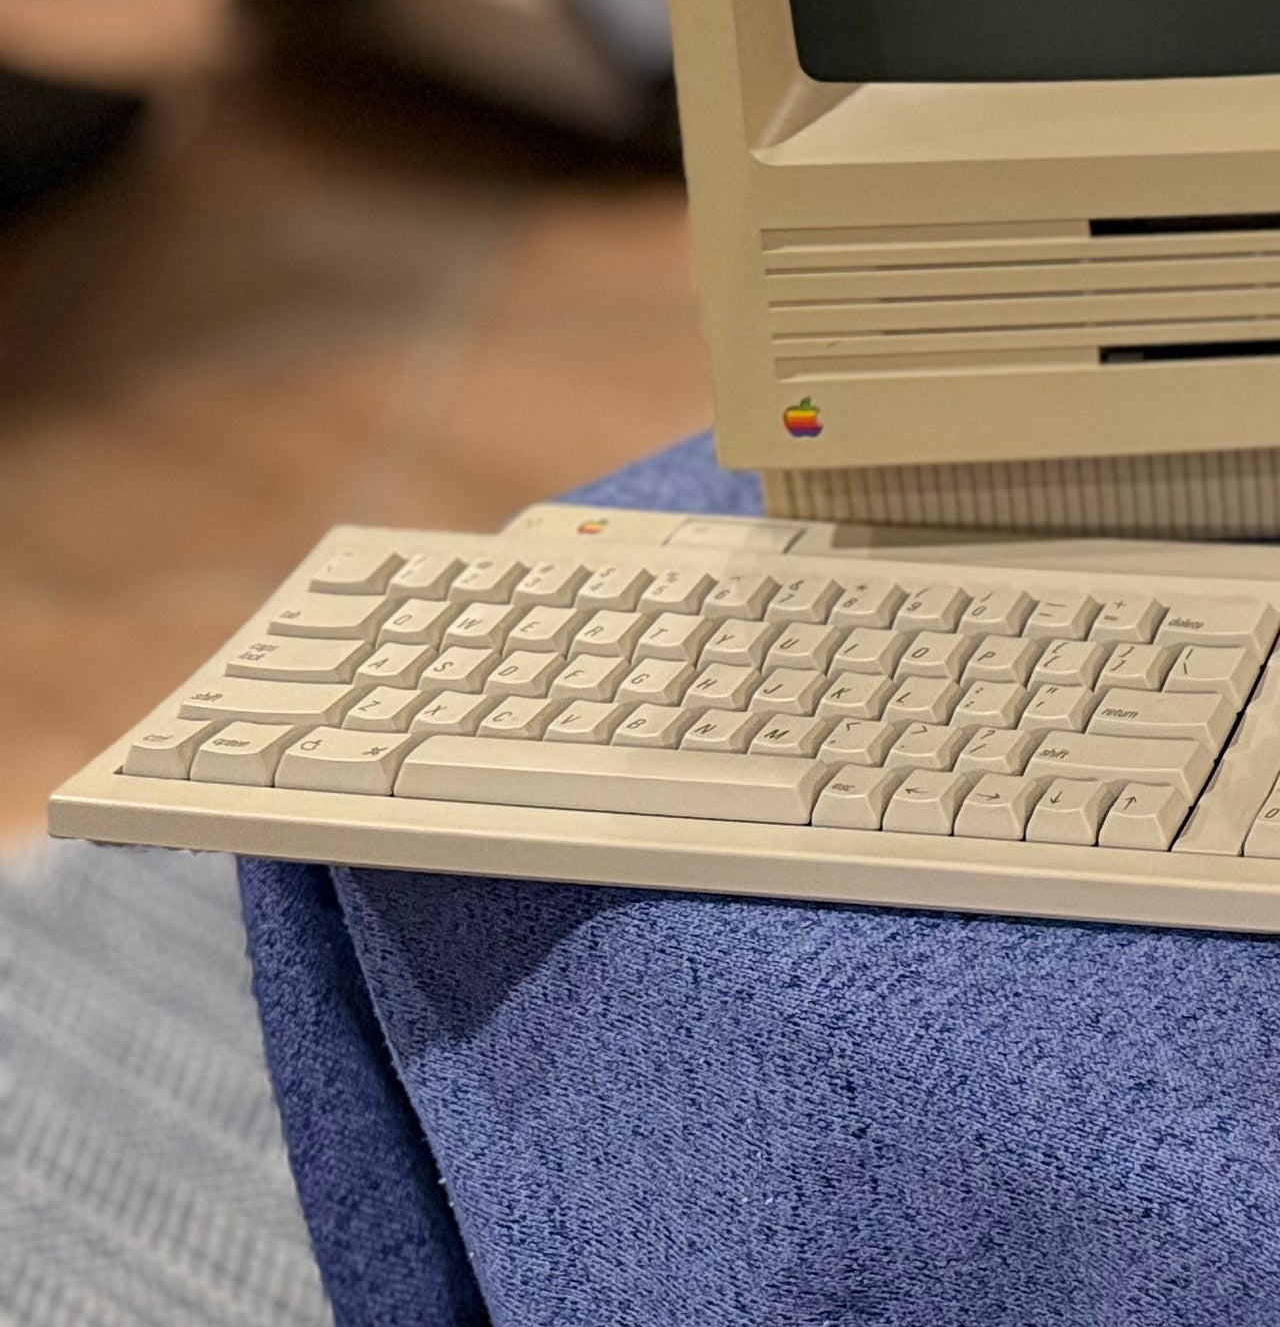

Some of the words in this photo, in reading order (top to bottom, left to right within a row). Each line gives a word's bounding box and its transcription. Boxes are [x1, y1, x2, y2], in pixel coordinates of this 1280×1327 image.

[714, 588, 731, 601] 6
[906, 601, 923, 612] 9
[456, 617, 483, 631] W
[519, 620, 542, 633] E
[1166, 617, 1205, 630] delete
[583, 625, 605, 638] R
[649, 628, 669, 640] T
[715, 633, 736, 646] Y
[779, 638, 800, 650] U
[249, 642, 279, 653] caps
[910, 647, 931, 659] O
[976, 650, 997, 663] P
[367, 657, 389, 670] A
[432, 661, 454, 673] S
[497, 665, 519, 677] D
[563, 669, 585, 681] F
[631, 673, 651, 686] G
[695, 677, 718, 690] H
[762, 683, 785, 695] J
[830, 687, 852, 700] K
[190, 691, 224, 703] shift
[895, 691, 912, 704] L
[358, 699, 382, 712] Z
[424, 704, 448, 717] X
[491, 711, 513, 723] C
[560, 713, 581, 726] V
[1101, 707, 1139, 720] return
[625, 717, 648, 730] B
[694, 723, 718, 735] N
[763, 727, 790, 740] M
[212, 737, 251, 748] option
[1038, 747, 1070, 760] shift
[1264, 807, 1280, 819] 0
